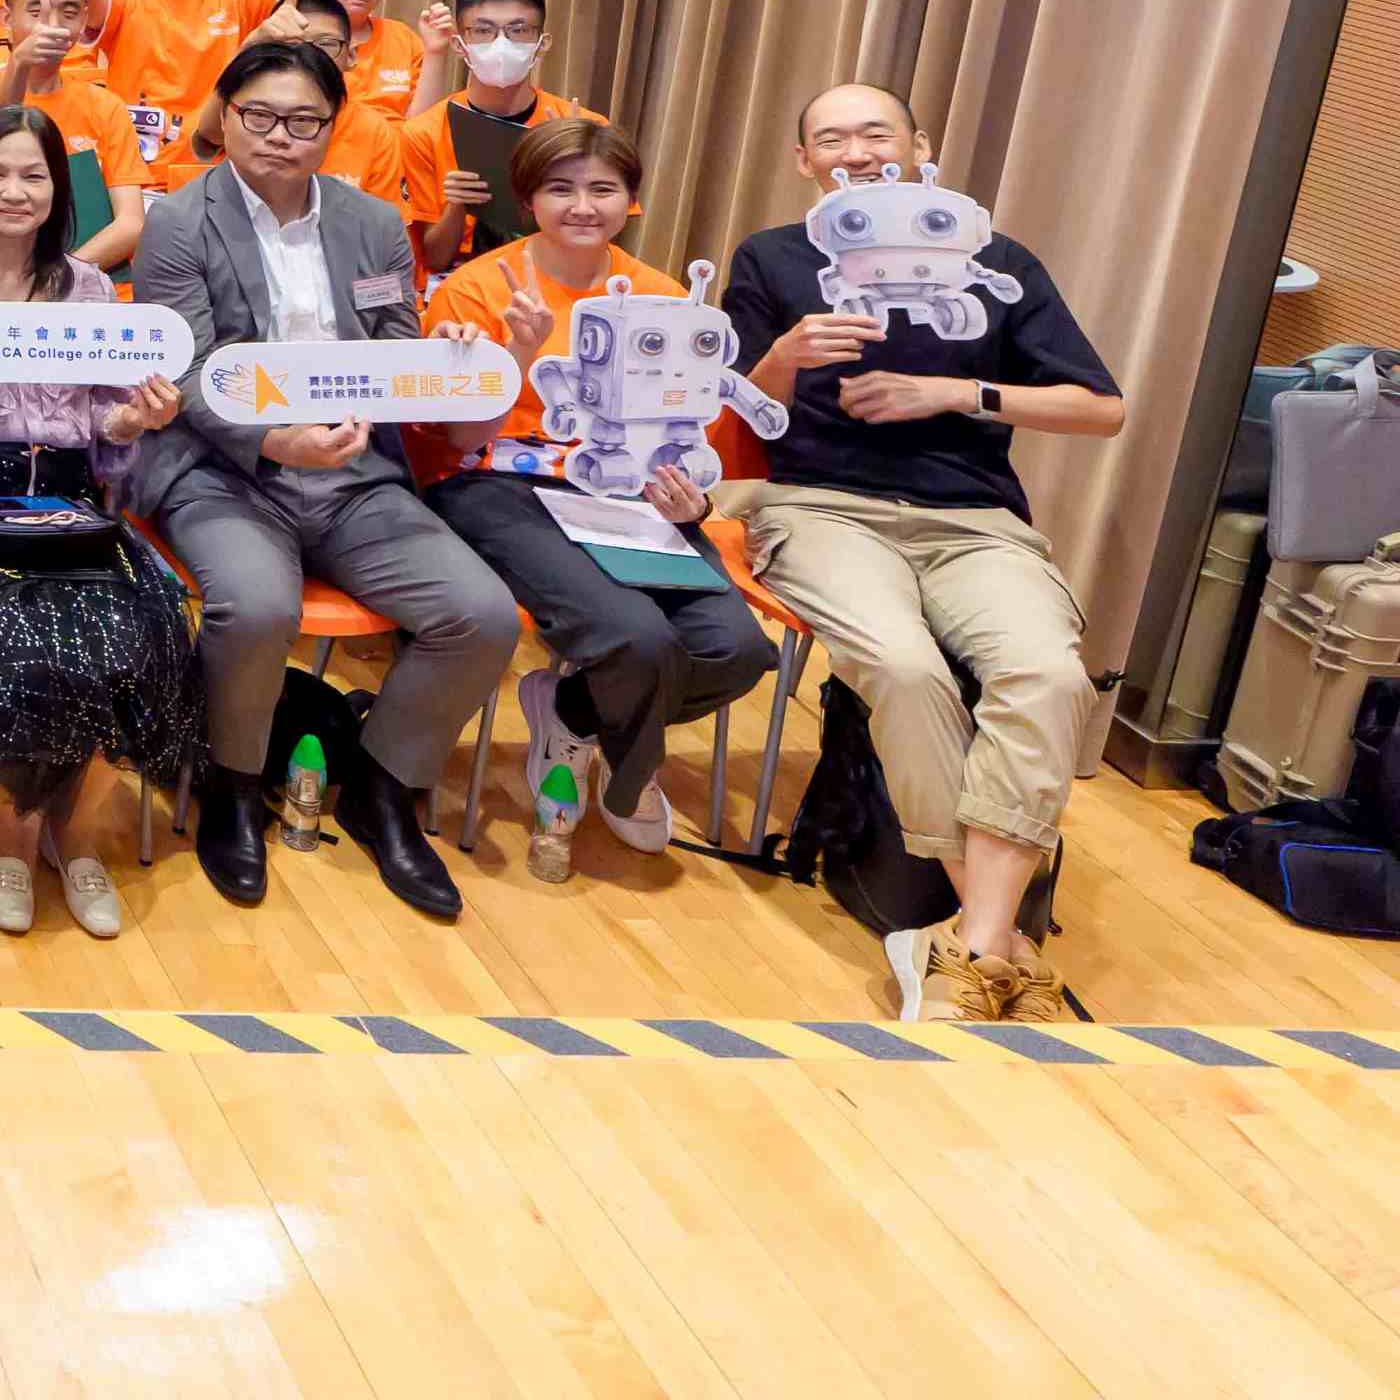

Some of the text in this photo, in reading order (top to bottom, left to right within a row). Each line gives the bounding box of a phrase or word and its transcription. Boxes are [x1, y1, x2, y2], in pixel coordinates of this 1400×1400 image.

[28, 347, 82, 361] College
[88, 348, 103, 360] of
[108, 348, 165, 361] Careers
